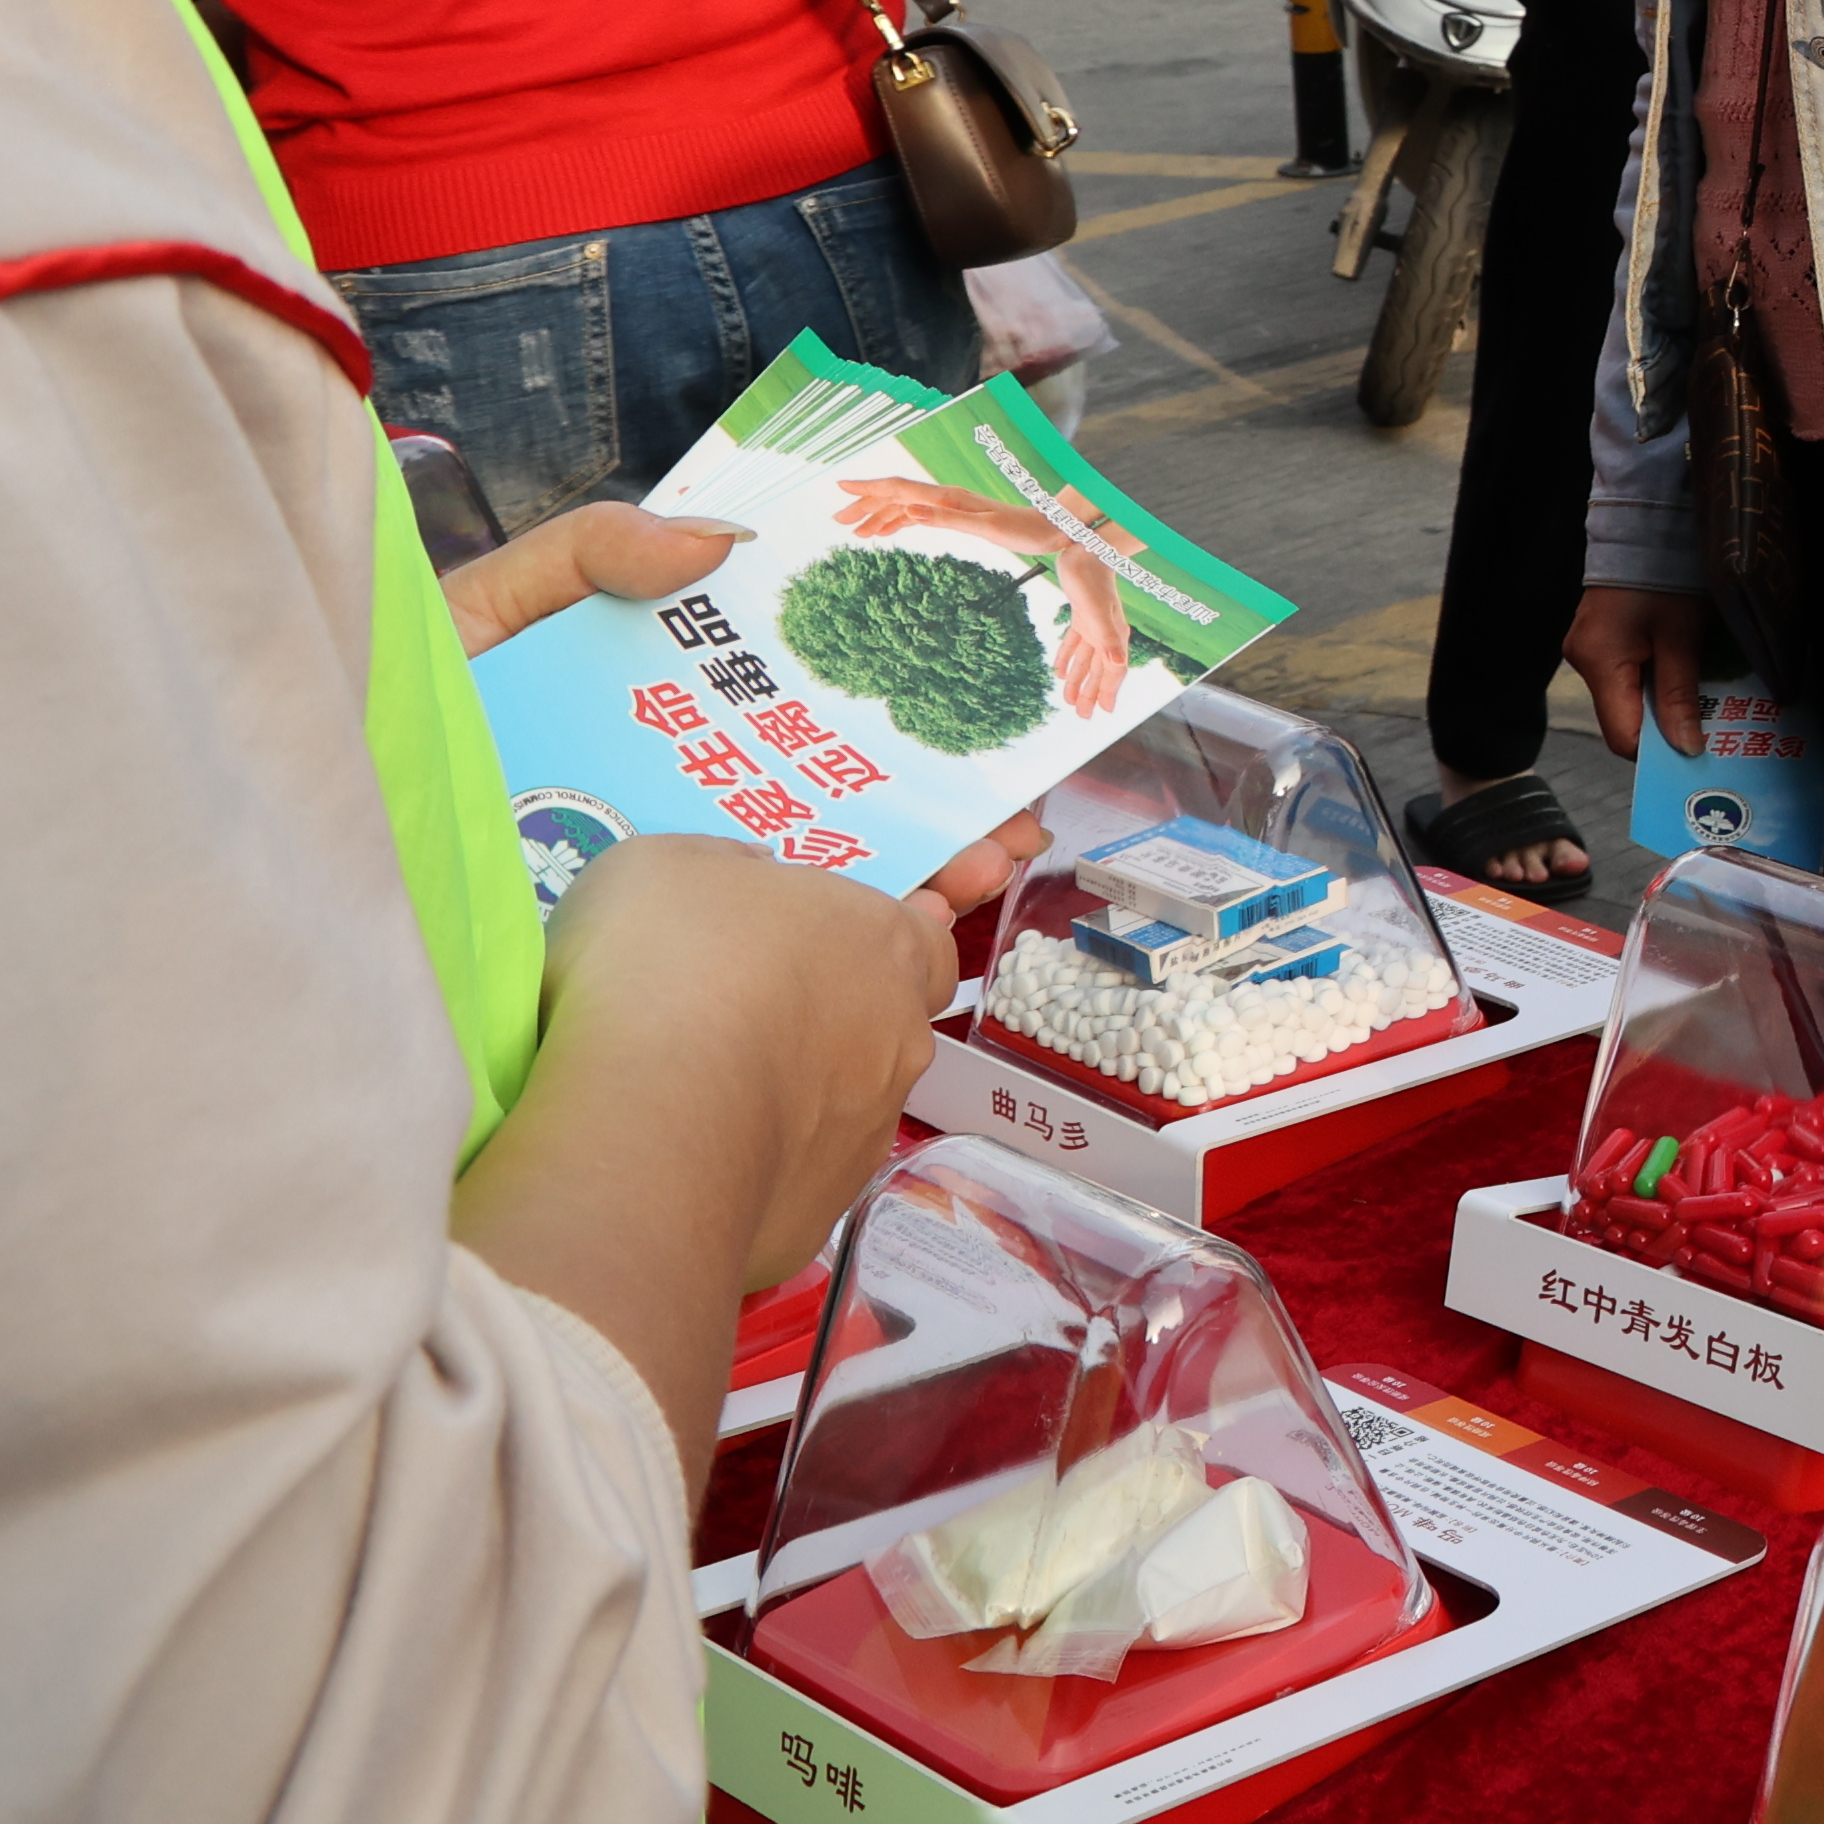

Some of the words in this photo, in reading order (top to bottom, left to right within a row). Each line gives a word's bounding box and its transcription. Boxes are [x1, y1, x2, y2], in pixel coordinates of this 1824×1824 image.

[656, 592, 892, 800] 远离毒品
[630, 680, 874, 870] 珍爱生命
[1704, 731, 1808, 758] 珍爱生
[555, 790, 604, 810] CONTROL
[604, 807, 636, 837] COTICS
[990, 1086, 1090, 1152] 曲马多
[1537, 1268, 1786, 1391] 红中青发白板
[778, 1729, 867, 1814] 吗啡
